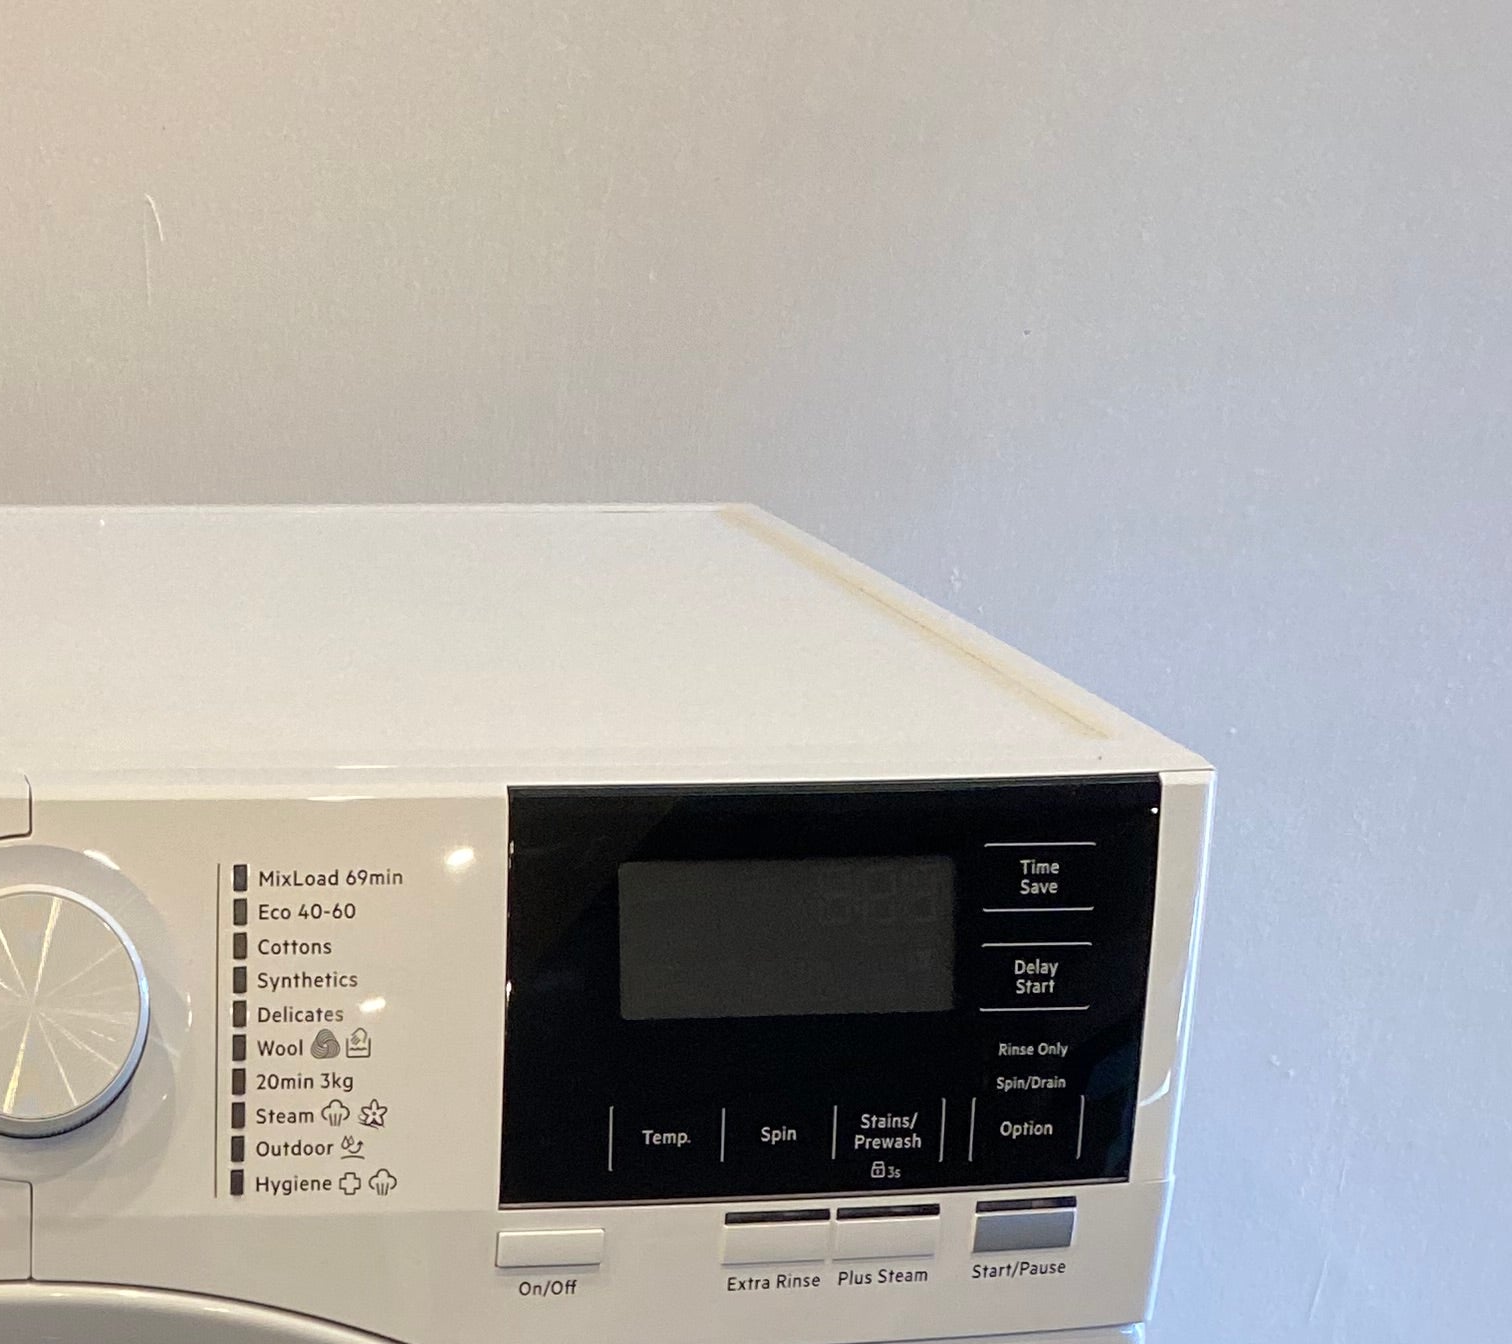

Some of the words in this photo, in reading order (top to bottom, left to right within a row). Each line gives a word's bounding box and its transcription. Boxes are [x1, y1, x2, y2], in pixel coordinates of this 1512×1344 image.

[1020, 858, 1060, 876] Time
[259, 870, 339, 886] MixLoad
[346, 869, 404, 886] 69min
[1020, 878, 1059, 895] Save
[258, 904, 291, 920] Eco
[298, 904, 356, 919] 40-60
[258, 939, 332, 955] Cottons
[1014, 958, 1058, 979] Delay
[257, 972, 358, 992] Synthetics
[1015, 977, 1055, 995] Start
[257, 1006, 344, 1023] Delicates
[257, 1039, 304, 1056] Wool
[998, 1042, 1033, 1057] Rinse
[1038, 1041, 1068, 1058] Only
[256, 1074, 314, 1089] 20min
[320, 1072, 354, 1092] 3kg
[996, 1074, 1067, 1092] Spin/Drain
[256, 1108, 314, 1124] Steam
[860, 1112, 919, 1130] Stains/
[760, 1124, 797, 1145] Spin
[999, 1119, 1053, 1139] Option
[642, 1128, 692, 1149] Temp.
[854, 1132, 922, 1150] Prewash
[256, 1141, 334, 1157] Outdoor
[887, 1165, 901, 1178] 3s
[256, 1177, 332, 1196] Hygiene
[837, 1268, 872, 1286] Plus
[875, 1267, 929, 1283] Steam
[971, 1260, 1067, 1279] Start/Pause
[517, 1278, 578, 1296] On/Off
[726, 1272, 771, 1291] Extra
[775, 1270, 822, 1289] Rinse
